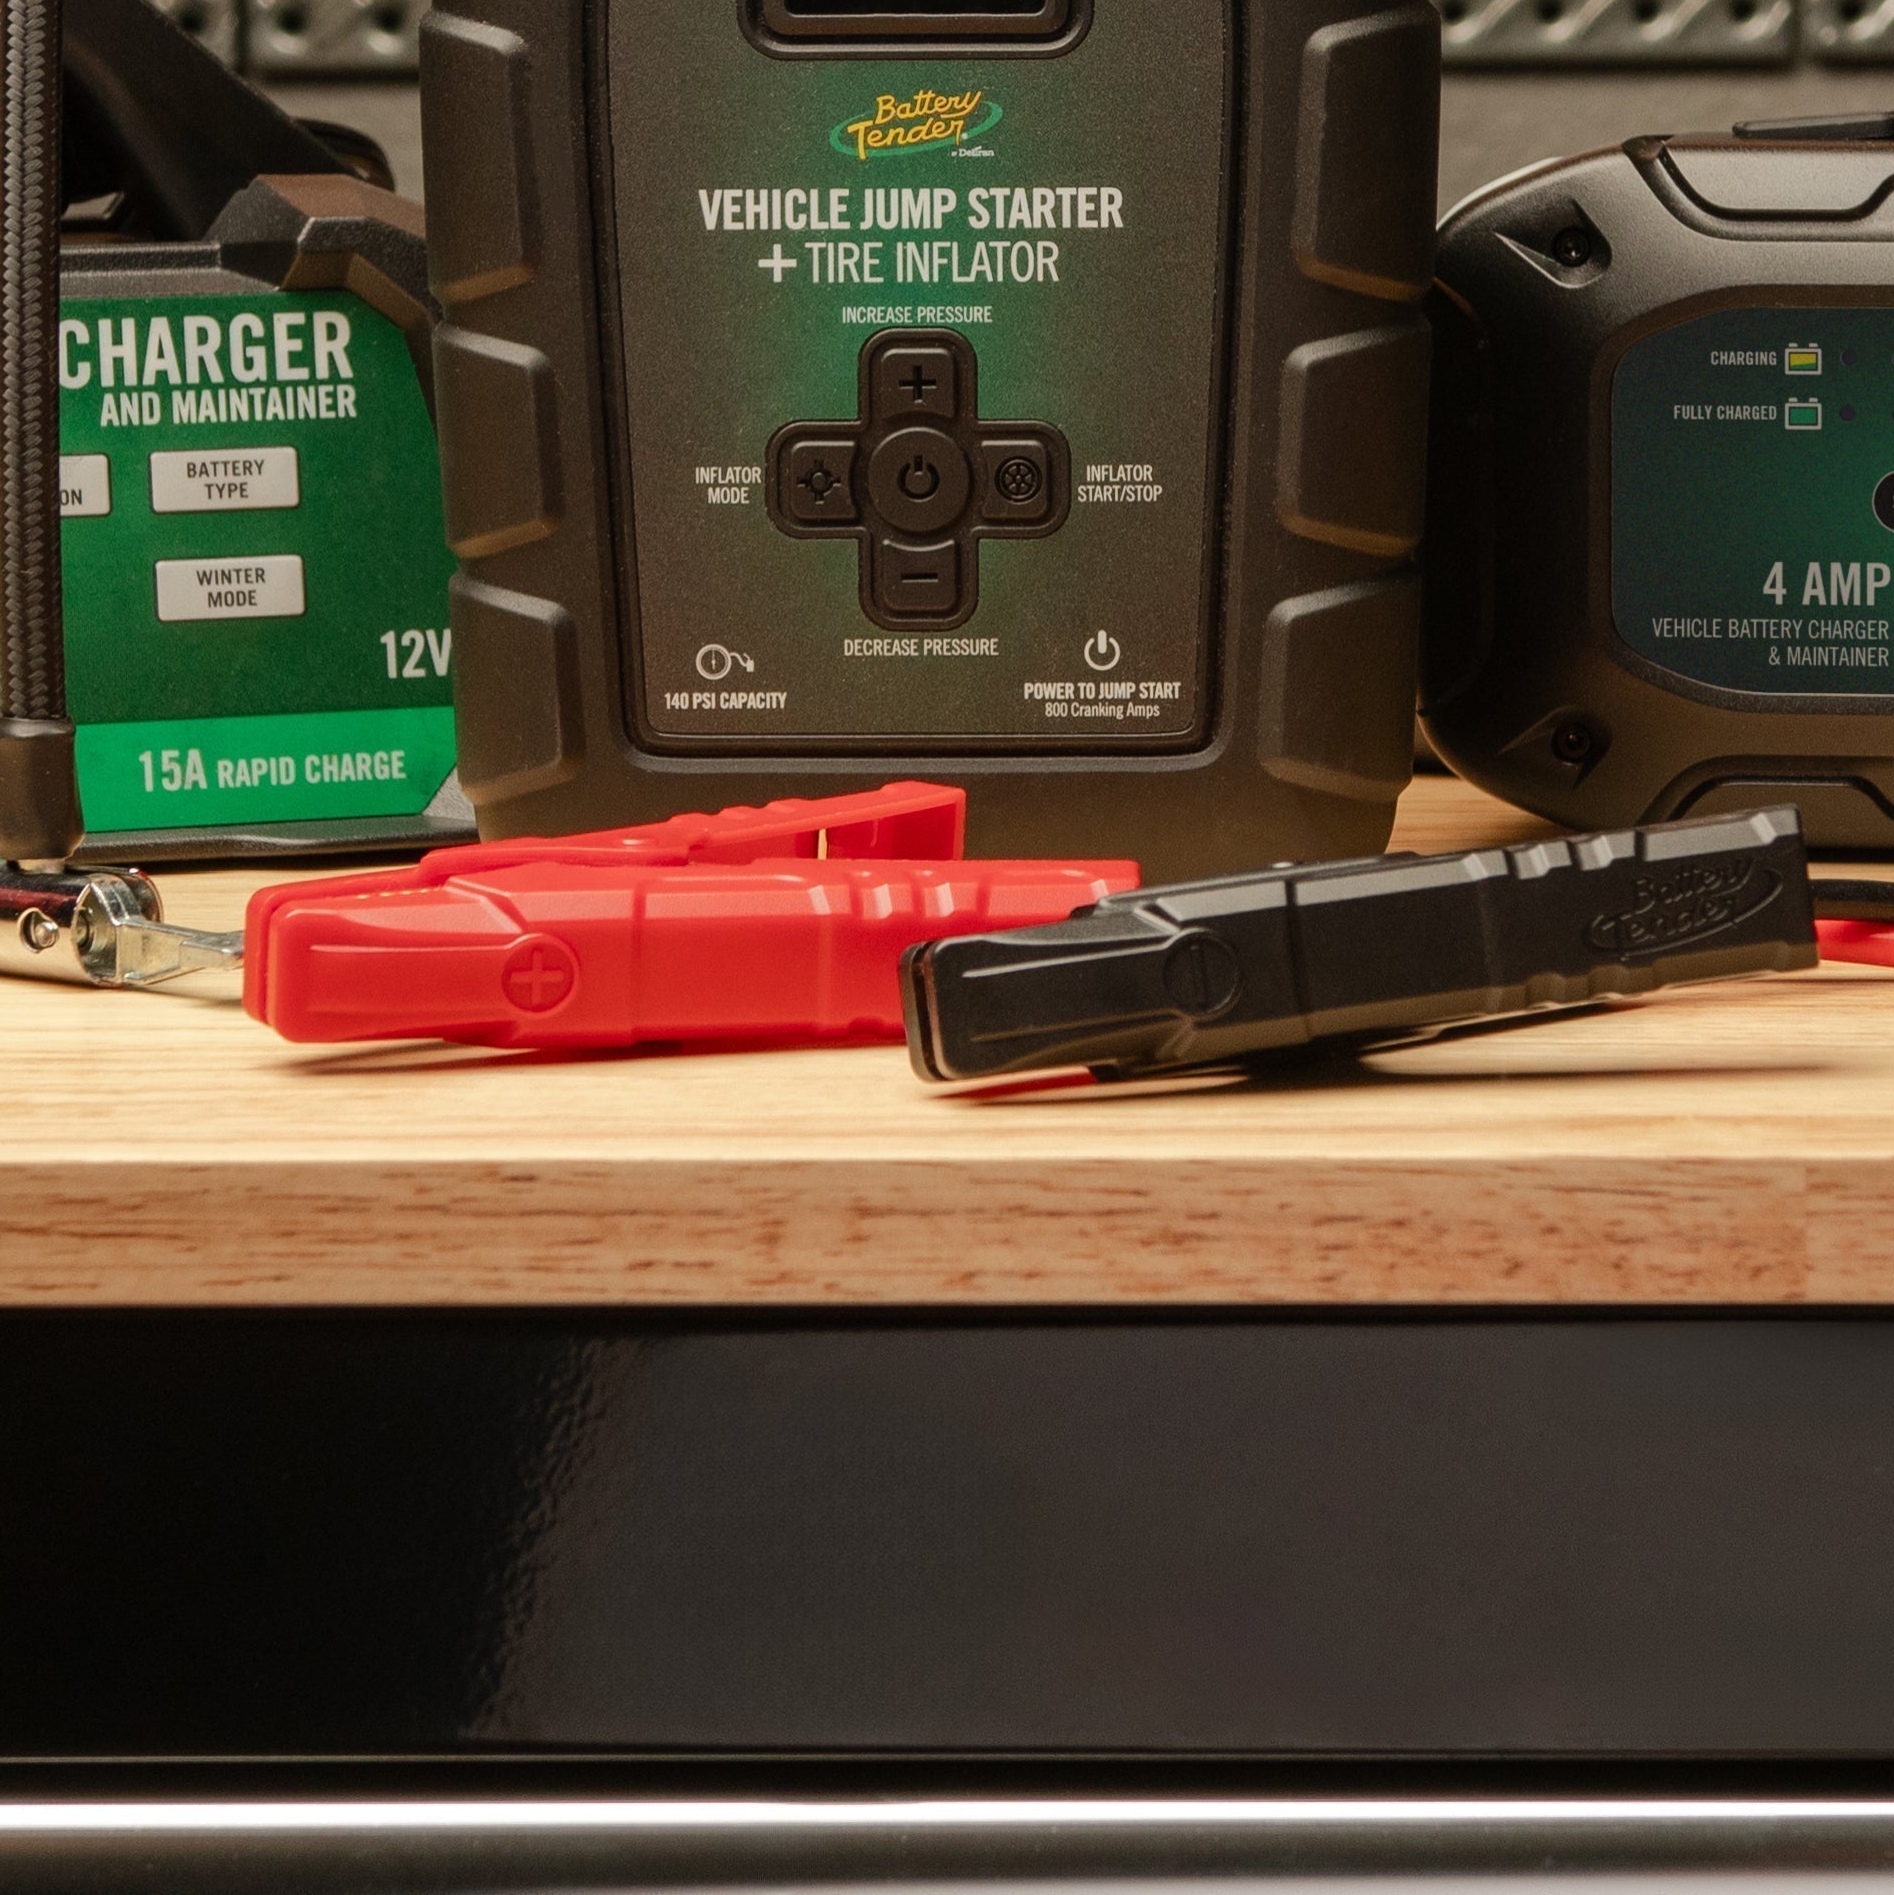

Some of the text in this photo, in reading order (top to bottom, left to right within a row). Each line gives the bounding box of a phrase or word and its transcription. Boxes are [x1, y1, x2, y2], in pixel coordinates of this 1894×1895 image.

[875, 89, 983, 123] Battery
[847, 116, 964, 161] Tender
[699, 187, 1124, 231] VEHICLE JUMP STARTER
[805, 241, 883, 283] TIRE
[896, 240, 1060, 283] INFLATOR
[841, 305, 993, 324] INCREASE PRESSURE
[59, 310, 353, 389] CHARGER
[1710, 351, 1778, 367] CHARGING
[100, 384, 357, 427] AND MAINTAINER
[1673, 405, 1778, 421] FULLY CHARGED
[185, 459, 265, 480] BATTERY
[695, 466, 762, 485] INFLATOR
[1086, 464, 1153, 482] INFLATOR
[204, 481, 249, 501] TYPE
[707, 486, 750, 504] MODE
[1077, 484, 1162, 503] START/STOP
[195, 566, 266, 588] WINTER
[1762, 562, 1891, 607] 4 AMP
[207, 588, 258, 609] MODE
[1652, 618, 1889, 641] VEHICLE BATTERY CHARGER
[380, 628, 452, 679] 12V
[843, 638, 999, 656] DECREASE PRESSURE
[1769, 646, 1889, 667] & MAINTAINER
[665, 691, 787, 709] 140 PSI CAPACITY
[1024, 682, 1181, 699] POWER TO JUMP START
[1045, 701, 1160, 720] 800 Cranking Amps
[138, 748, 405, 793] 15A RAPID CHARGE
